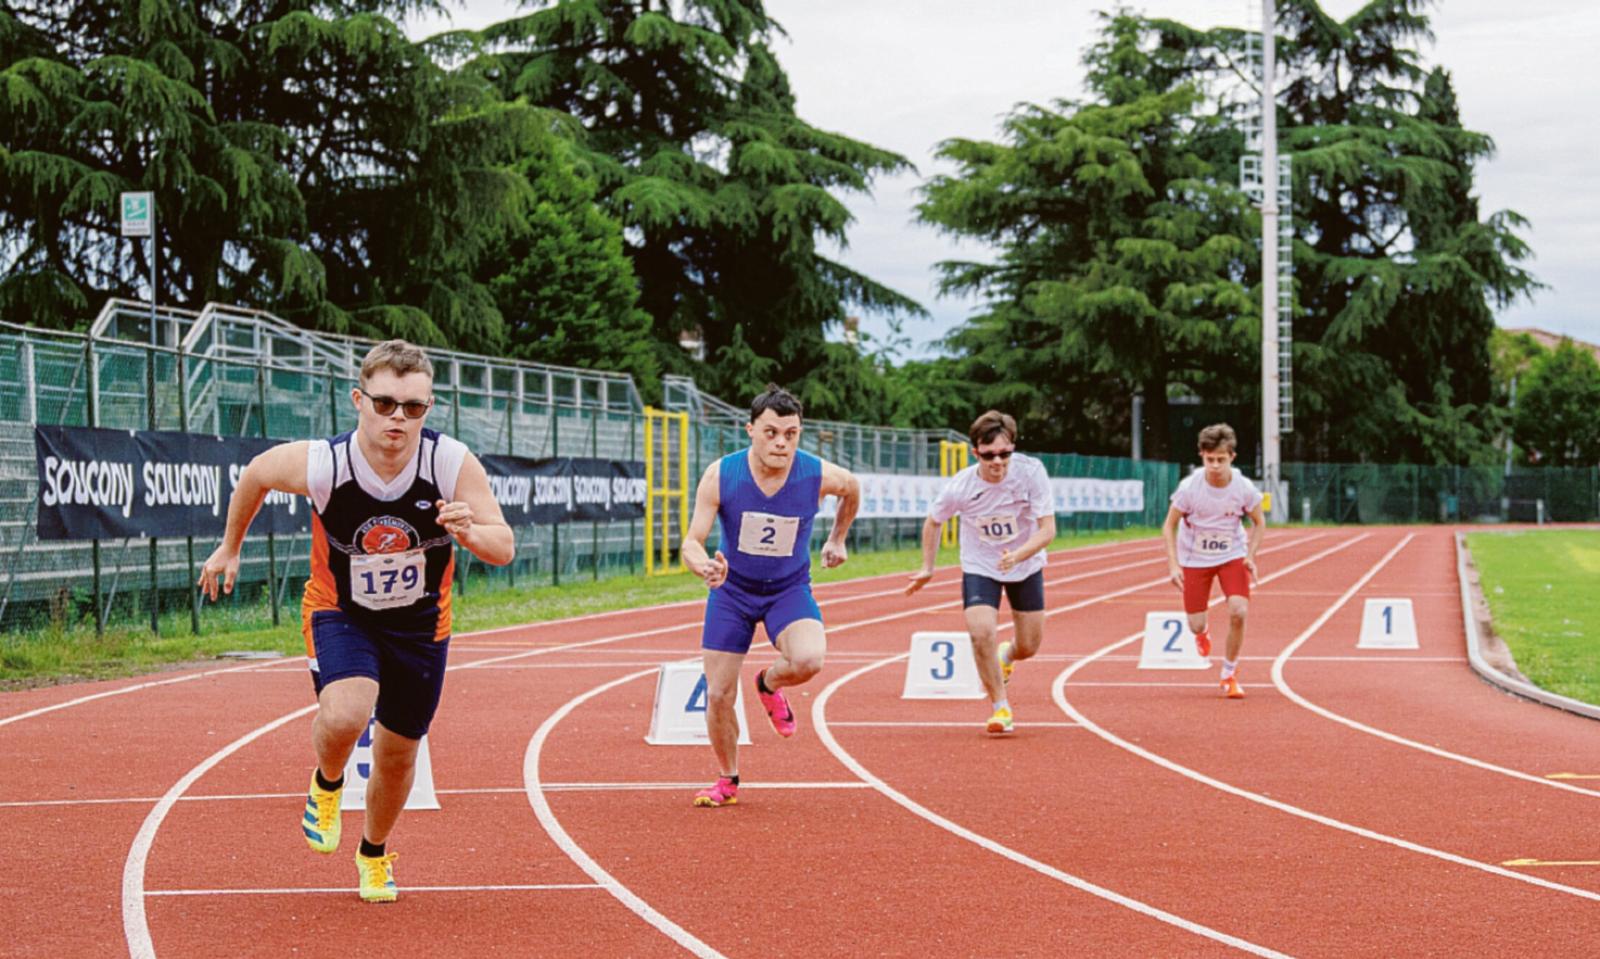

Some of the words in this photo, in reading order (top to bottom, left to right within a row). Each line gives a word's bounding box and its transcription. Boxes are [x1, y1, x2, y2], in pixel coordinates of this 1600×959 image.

[43, 456, 134, 518] saucony
[143, 461, 222, 517] saucony
[533, 475, 572, 511] saucony
[573, 475, 611, 511] saucony
[760, 526, 776, 544] 2
[981, 522, 1013, 537] 101
[1202, 539, 1229, 550] 106
[361, 565, 418, 594] 179
[1382, 606, 1392, 634] 1
[1162, 619, 1183, 652] 2
[930, 641, 954, 680] 3
